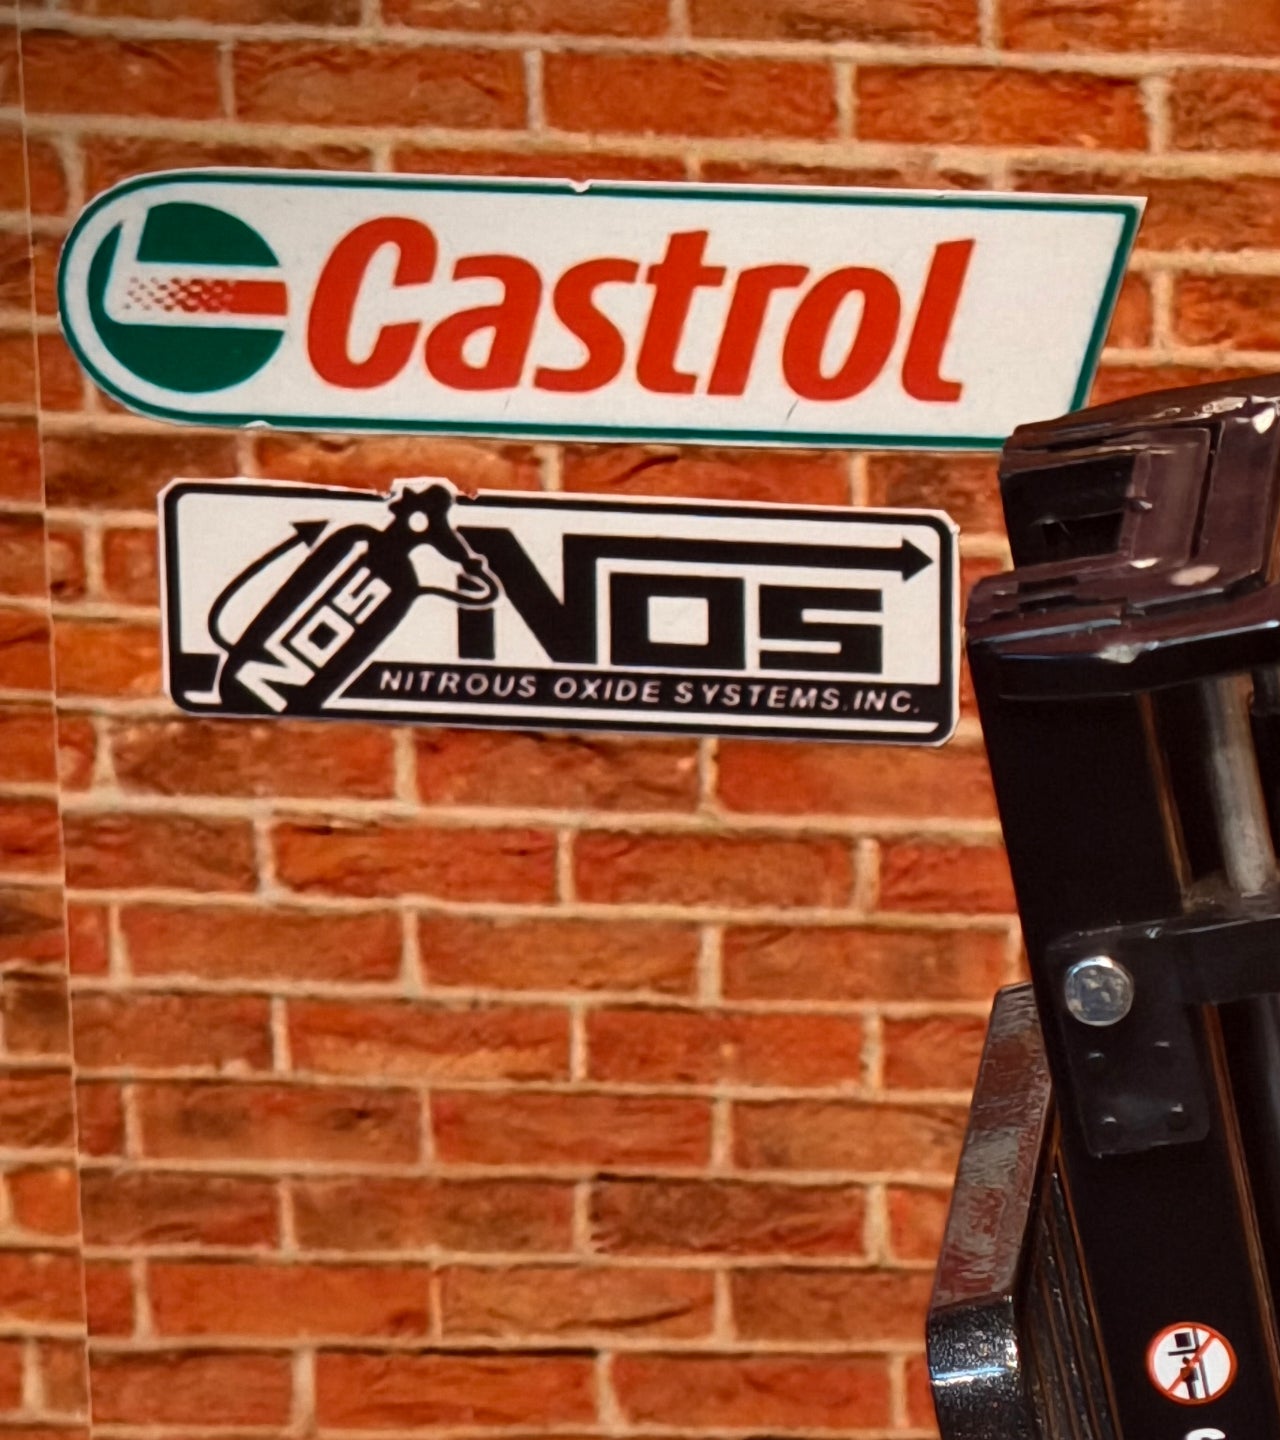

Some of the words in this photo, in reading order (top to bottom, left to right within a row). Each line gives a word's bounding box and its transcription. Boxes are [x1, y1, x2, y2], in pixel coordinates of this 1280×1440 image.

[305, 216, 976, 402] Castrol
[235, 540, 392, 713] NOS
[455, 525, 884, 675] NOS
[379, 669, 538, 698] NITROUS
[553, 676, 662, 703] OXIDE
[853, 689, 922, 714] INC.
